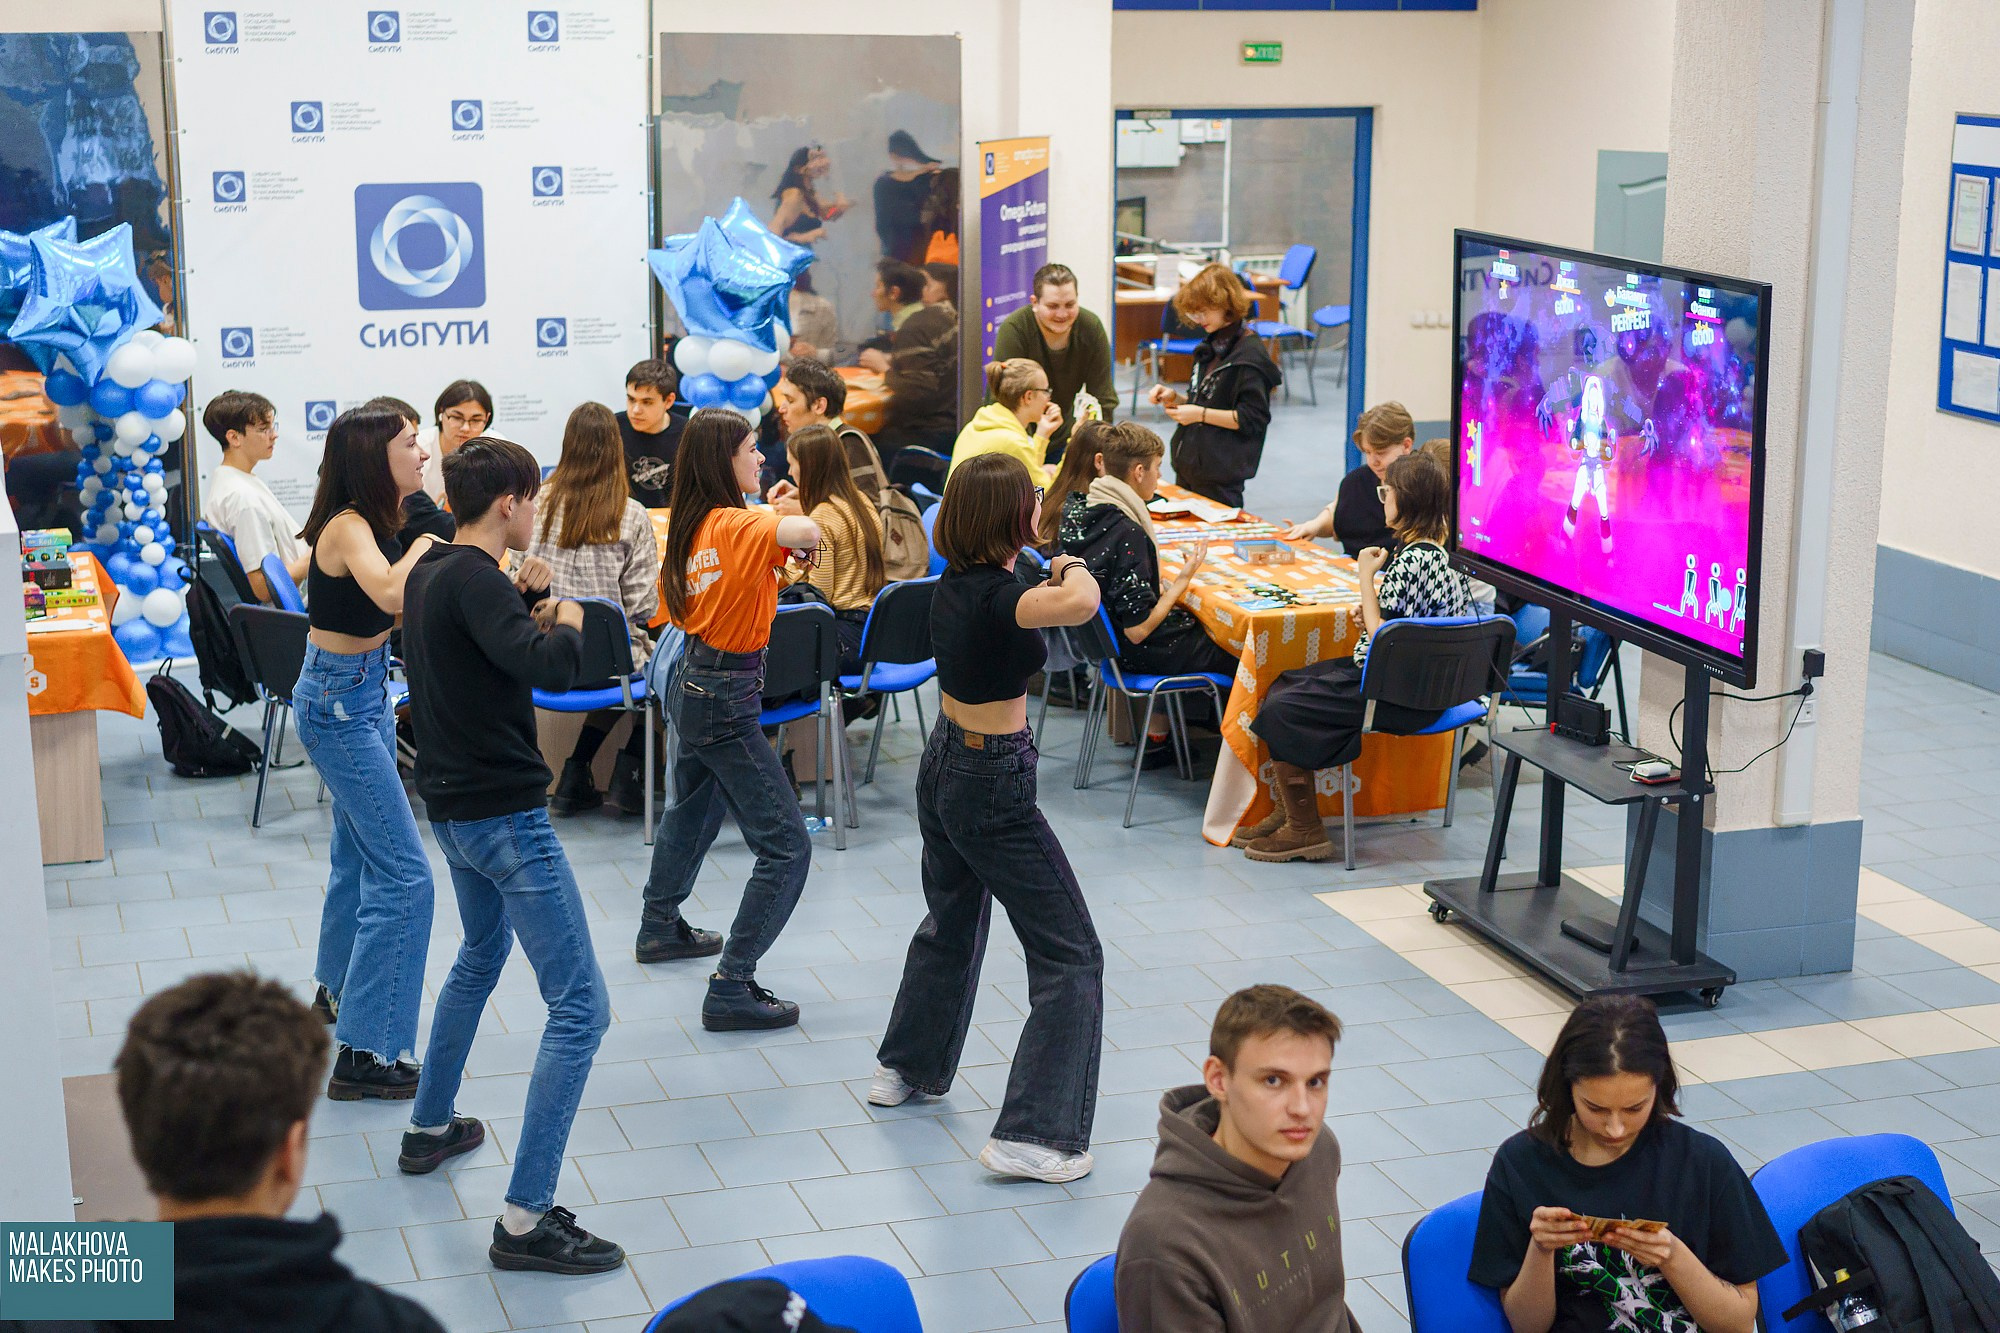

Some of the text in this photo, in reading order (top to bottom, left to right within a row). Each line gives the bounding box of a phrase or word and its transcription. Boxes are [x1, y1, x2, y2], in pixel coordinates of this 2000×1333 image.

[1611, 310, 1651, 332] PERFECT
[360, 321, 490, 348] СибГУТИ
[1691, 328, 1714, 346] GOOD
